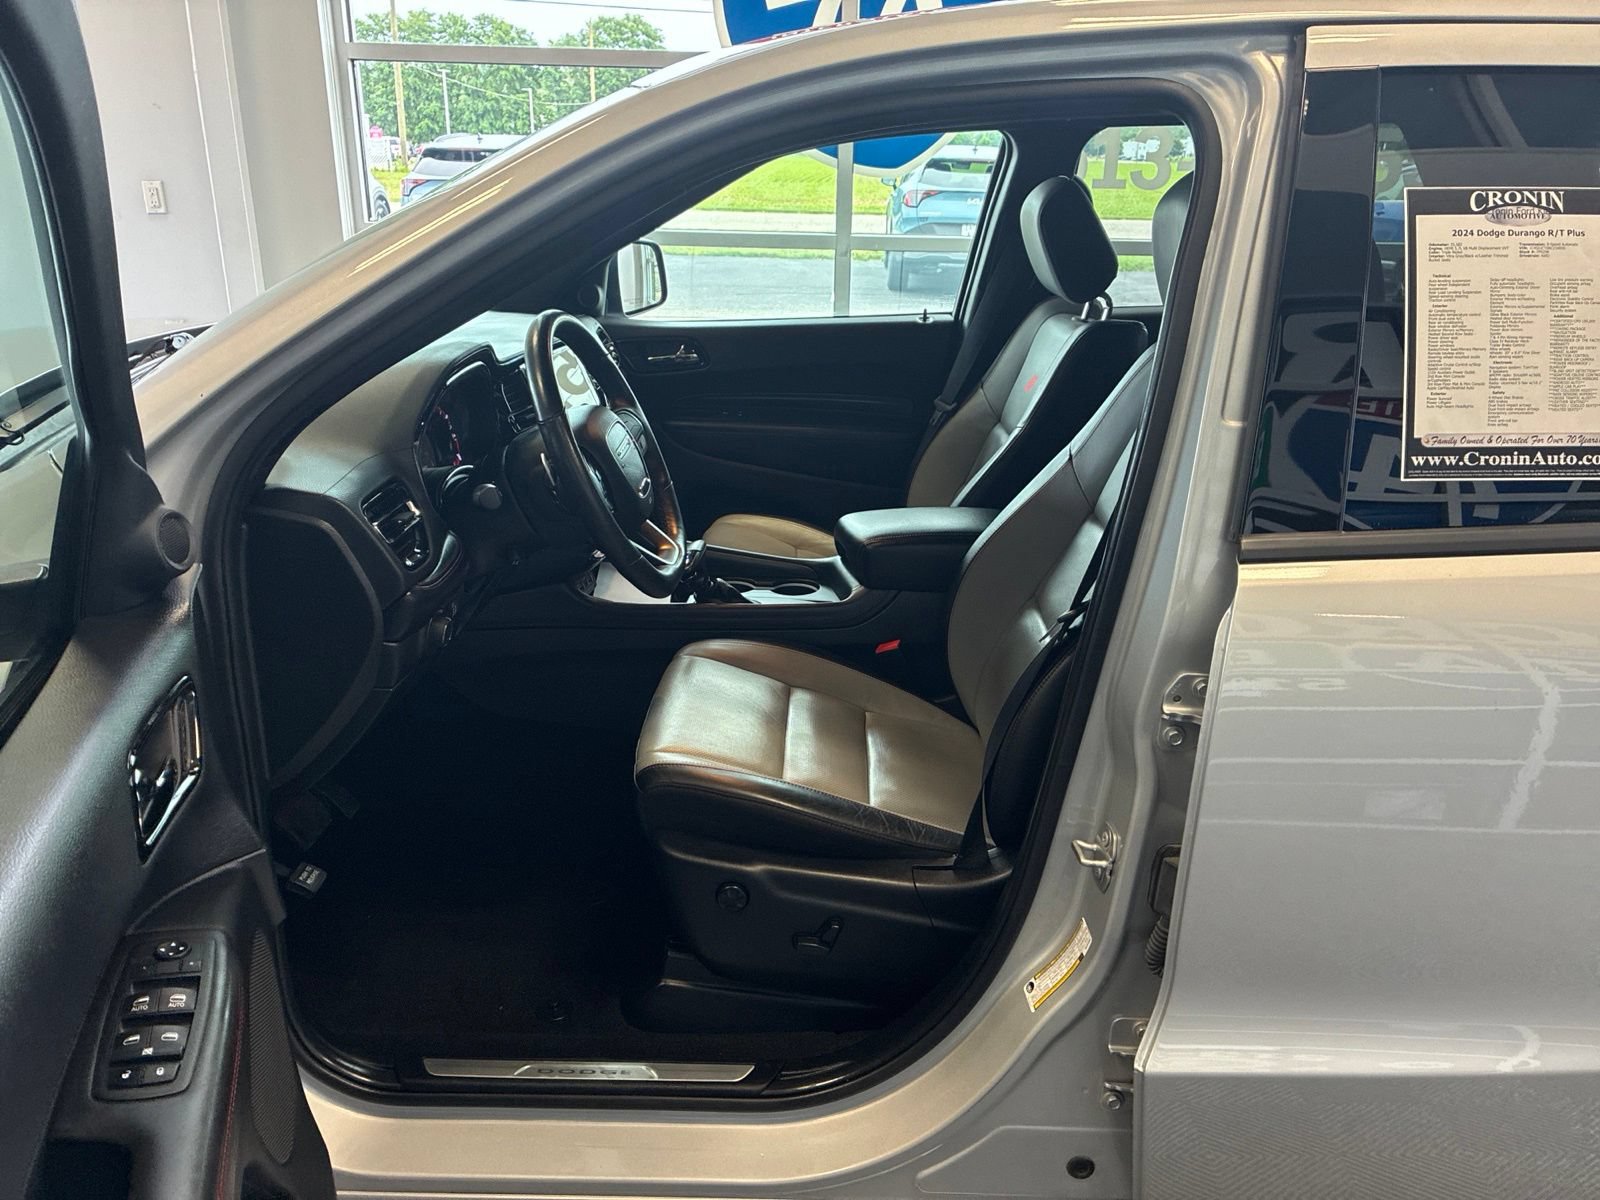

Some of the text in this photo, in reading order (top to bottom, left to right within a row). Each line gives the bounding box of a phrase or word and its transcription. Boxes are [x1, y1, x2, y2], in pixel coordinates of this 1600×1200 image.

[1469, 190, 1565, 213] CRONIN
[1477, 229, 1505, 239] Dodge
[1508, 229, 1545, 239] Durango
[1548, 229, 1565, 238] R/T
[1567, 229, 1586, 237] Plus
[1431, 436, 1458, 445] Family
[1460, 436, 1484, 444] Owned
[1487, 436, 1493, 444] &
[1496, 436, 1529, 445] Operated
[1531, 435, 1544, 445] For
[1547, 435, 1563, 443] Over
[1567, 435, 1577, 443] 70
[1411, 451, 1600, 466] www.CroninAuto.co
